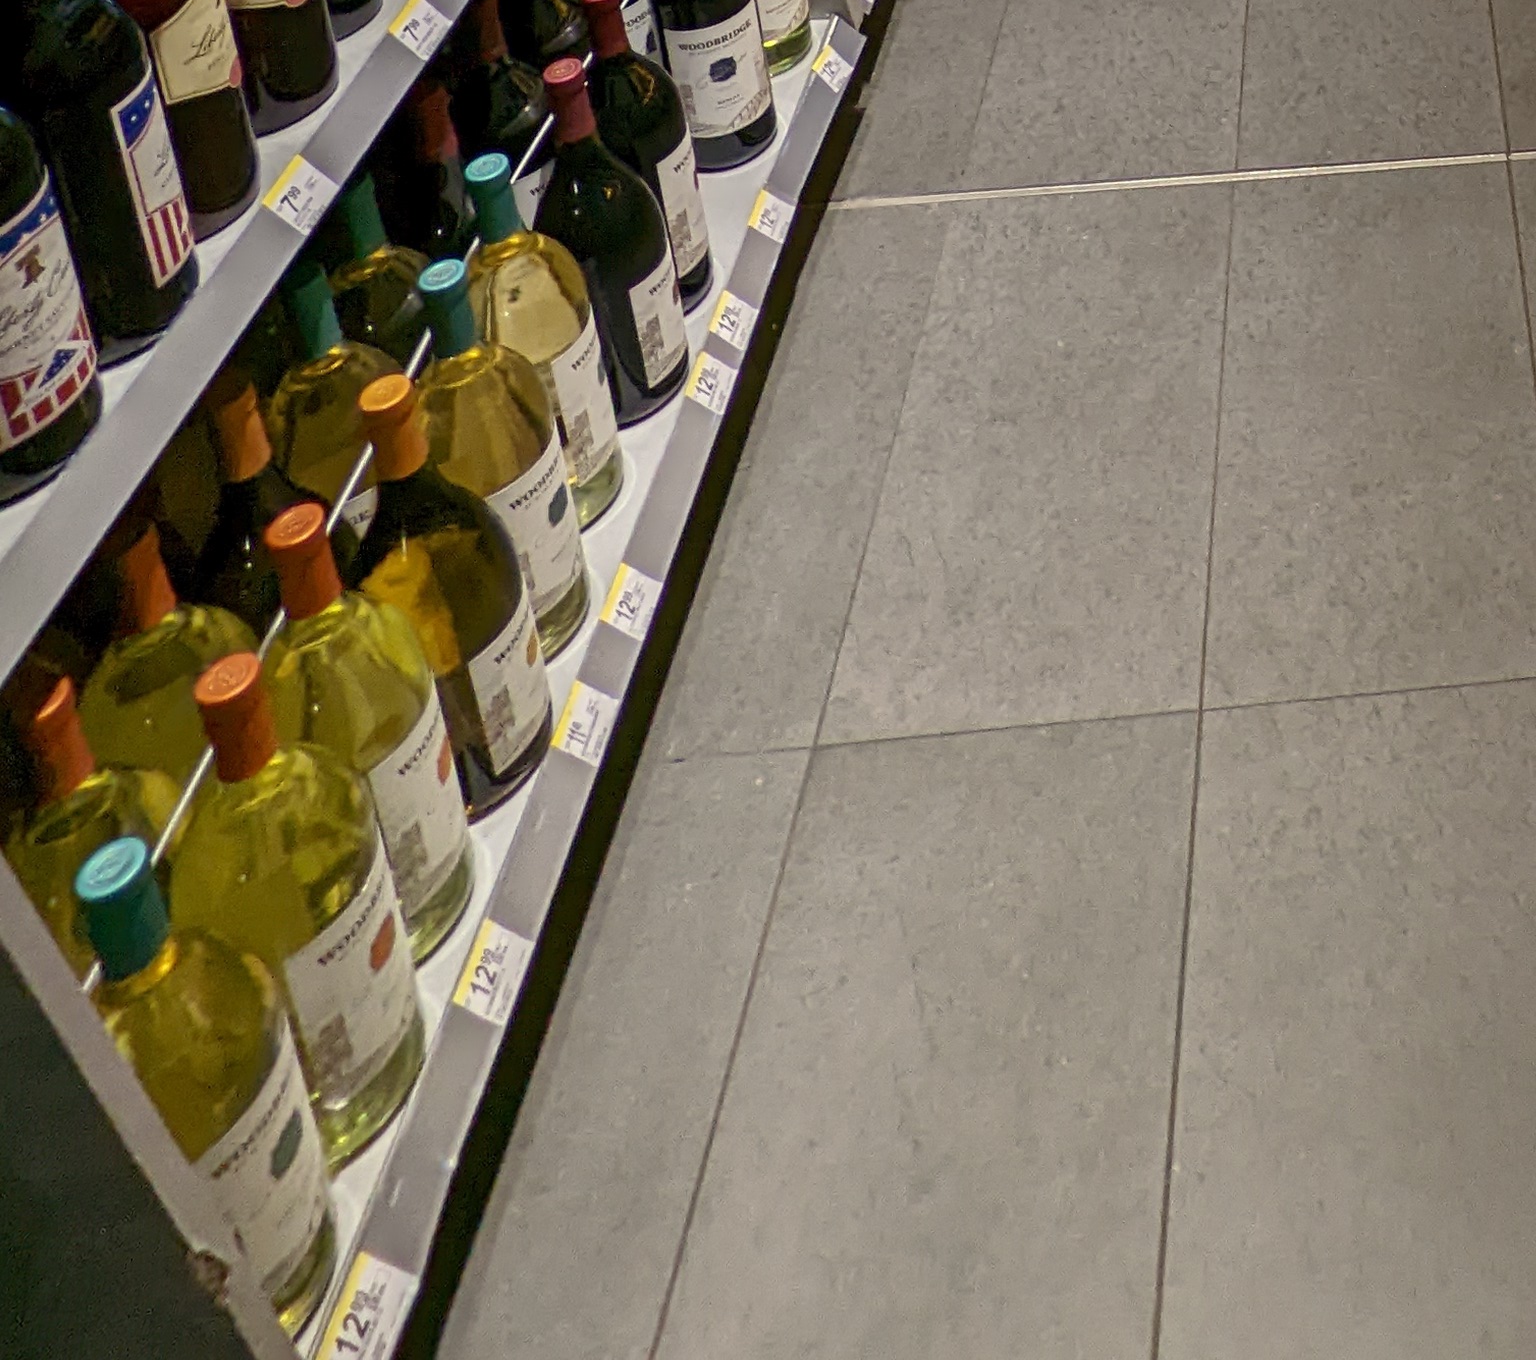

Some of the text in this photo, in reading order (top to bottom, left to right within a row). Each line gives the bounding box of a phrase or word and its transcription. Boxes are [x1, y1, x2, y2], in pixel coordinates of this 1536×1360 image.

[402, 17, 421, 42] 799
[678, 17, 753, 54] WOODBRIDGE
[279, 184, 303, 213] 799
